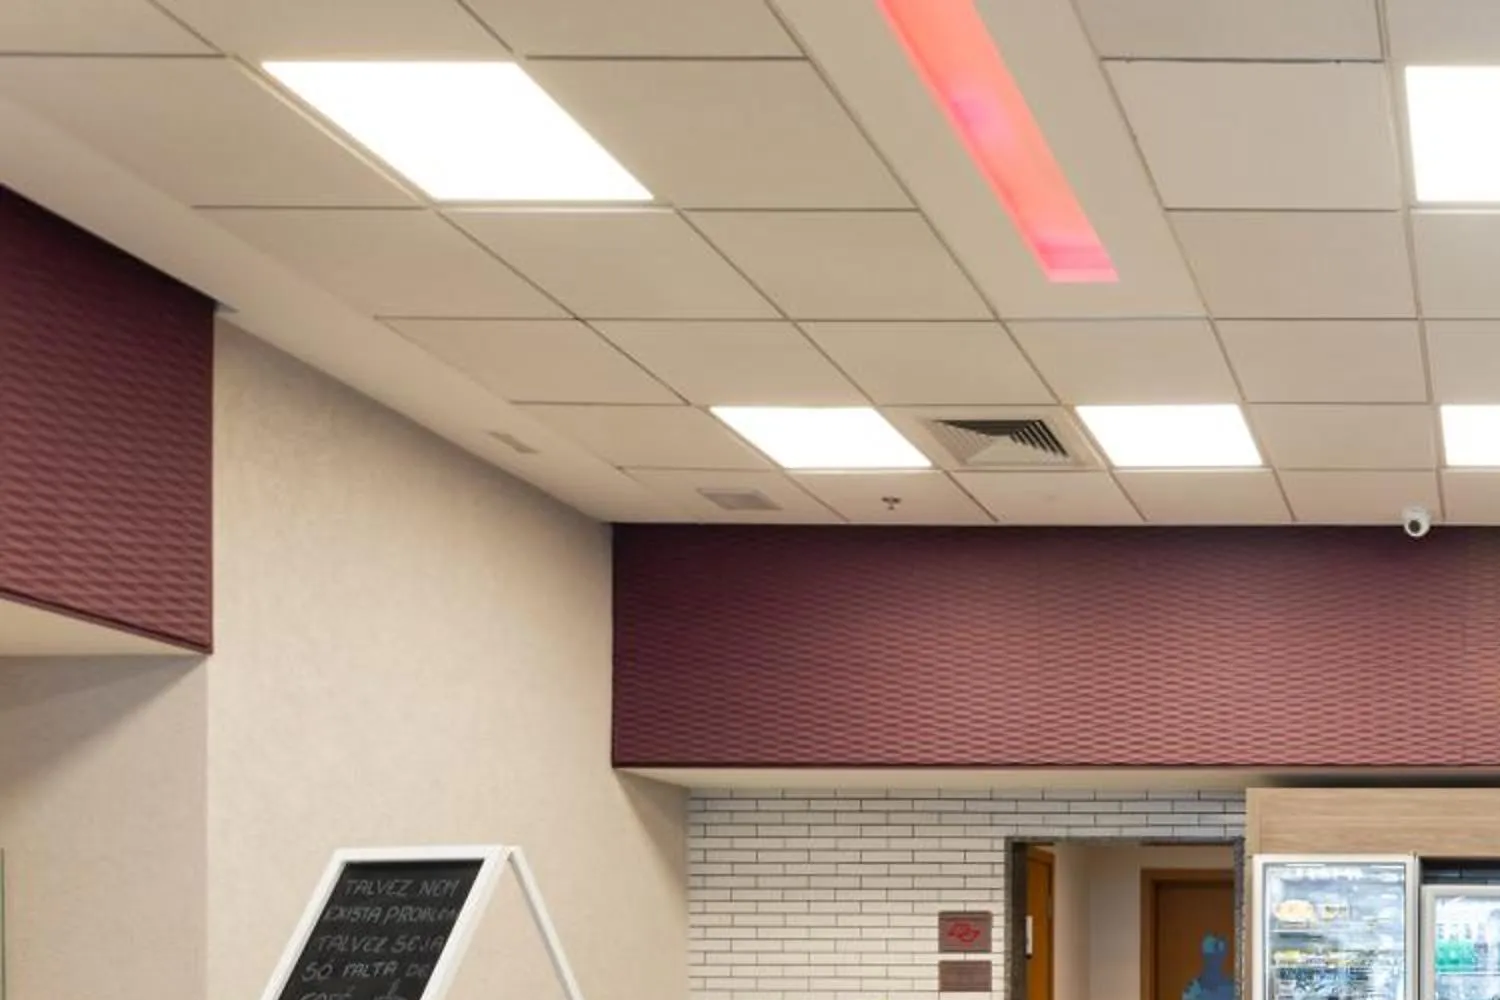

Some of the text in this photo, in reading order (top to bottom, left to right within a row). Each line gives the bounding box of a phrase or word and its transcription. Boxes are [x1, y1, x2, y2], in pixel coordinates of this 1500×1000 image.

[346, 879, 461, 897] TALVEZ NEM
[322, 905, 383, 925] EXISTA
[317, 934, 445, 954] TALVEZ SEJA
[344, 961, 398, 977] FALTA
